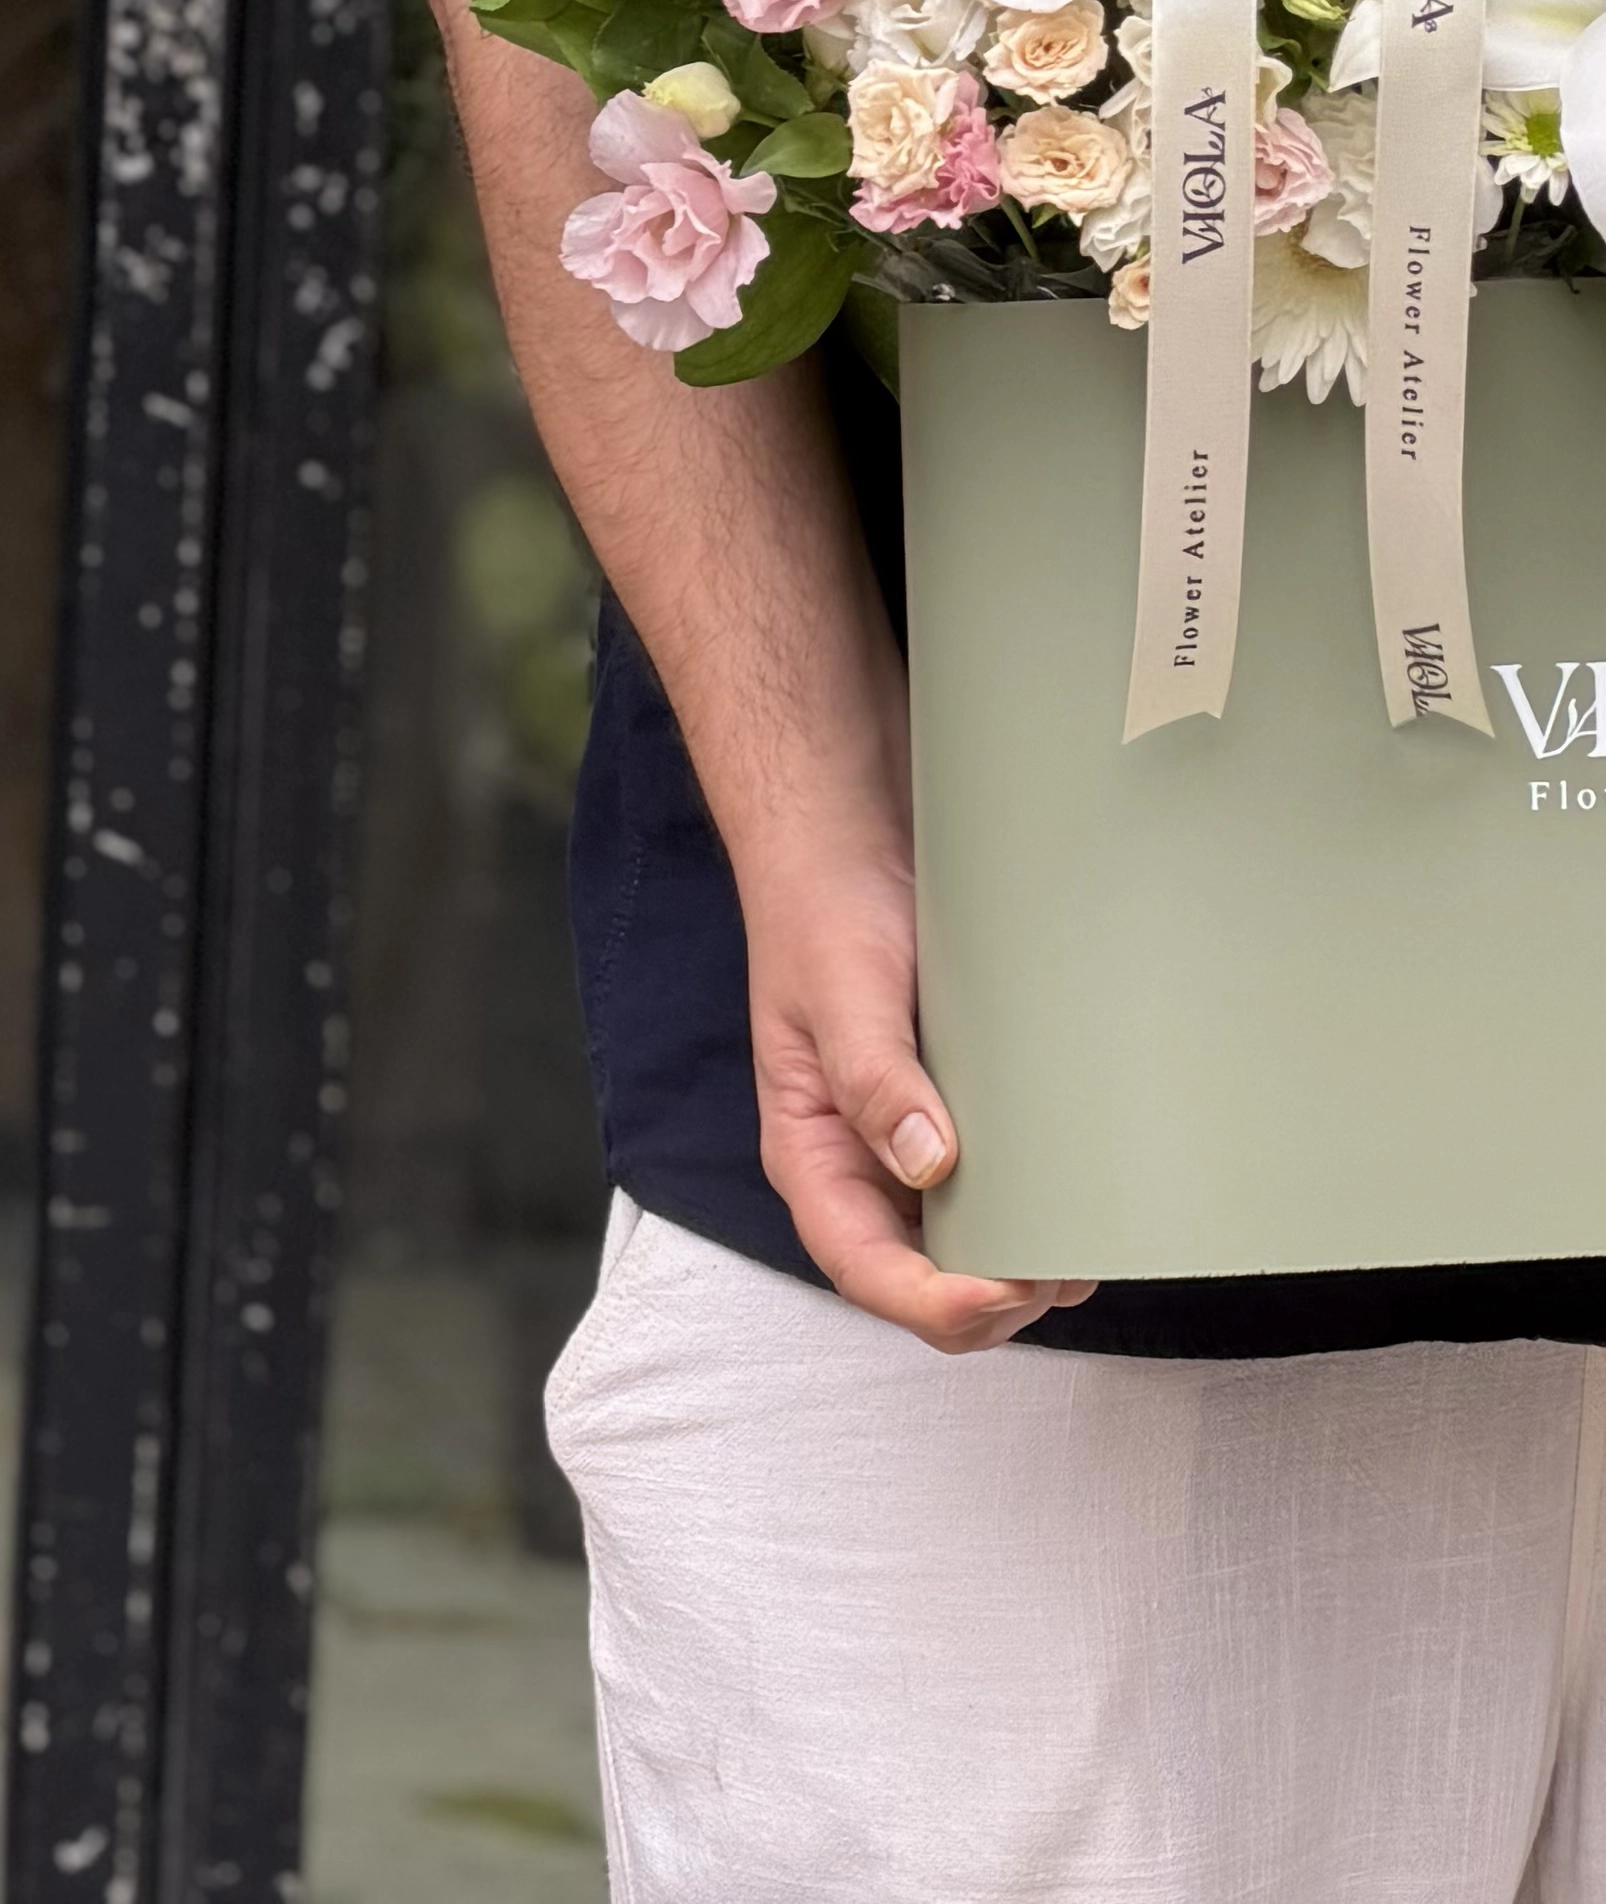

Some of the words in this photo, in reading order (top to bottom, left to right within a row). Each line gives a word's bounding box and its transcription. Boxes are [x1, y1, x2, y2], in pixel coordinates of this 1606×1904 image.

[1181, 86, 1227, 265] VIOLA
[1404, 225, 1431, 335] Flower
[1401, 349, 1425, 461] Atelier
[1182, 449, 1209, 560] Atelier
[1173, 575, 1203, 668] Flower
[1402, 622, 1453, 718] VIOL
